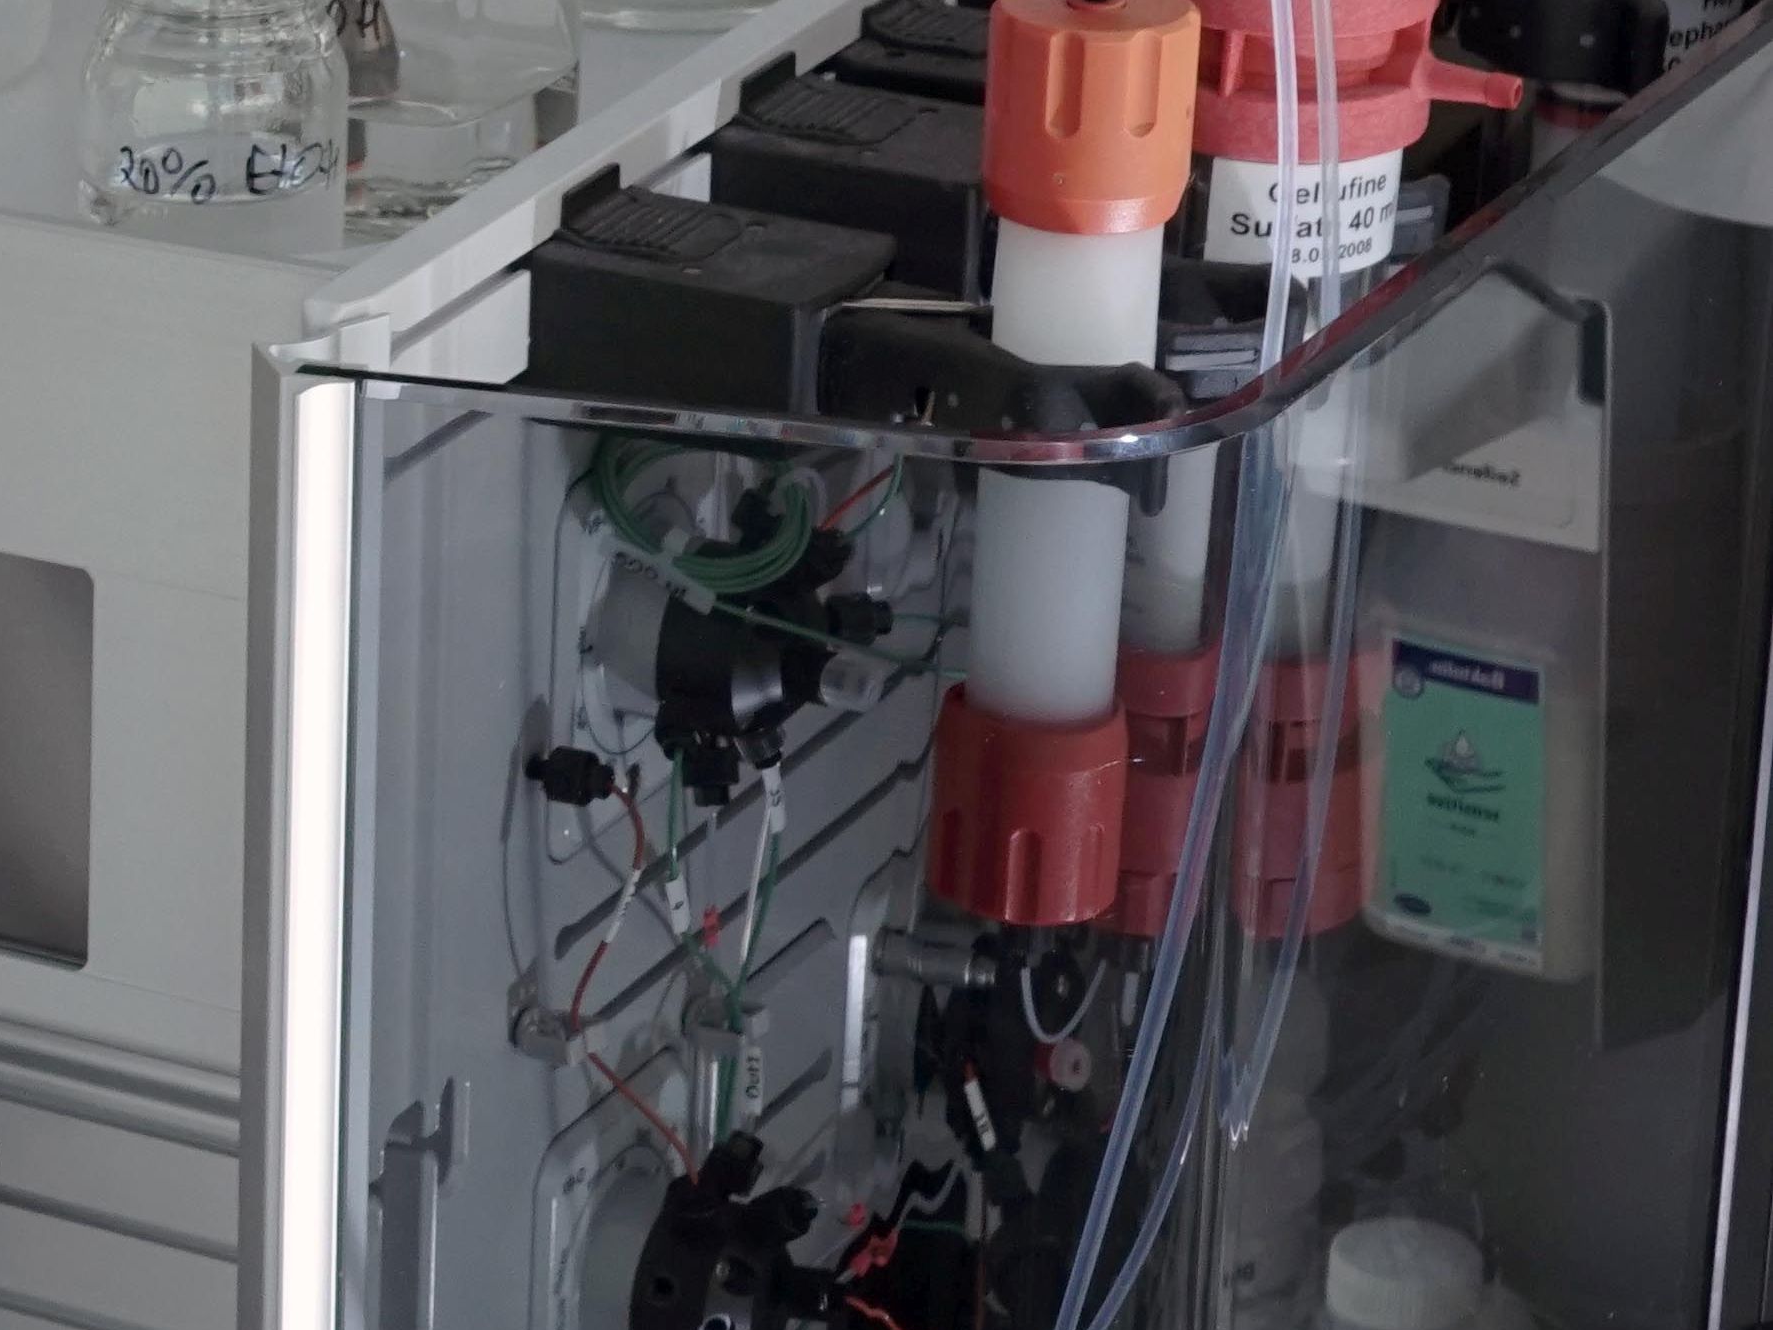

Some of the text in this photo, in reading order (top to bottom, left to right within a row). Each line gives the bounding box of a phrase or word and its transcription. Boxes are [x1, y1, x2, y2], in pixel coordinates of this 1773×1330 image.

[119, 145, 216, 204] 20%
[1268, 173, 1387, 205] Celufine
[1348, 206, 1375, 231] 40
